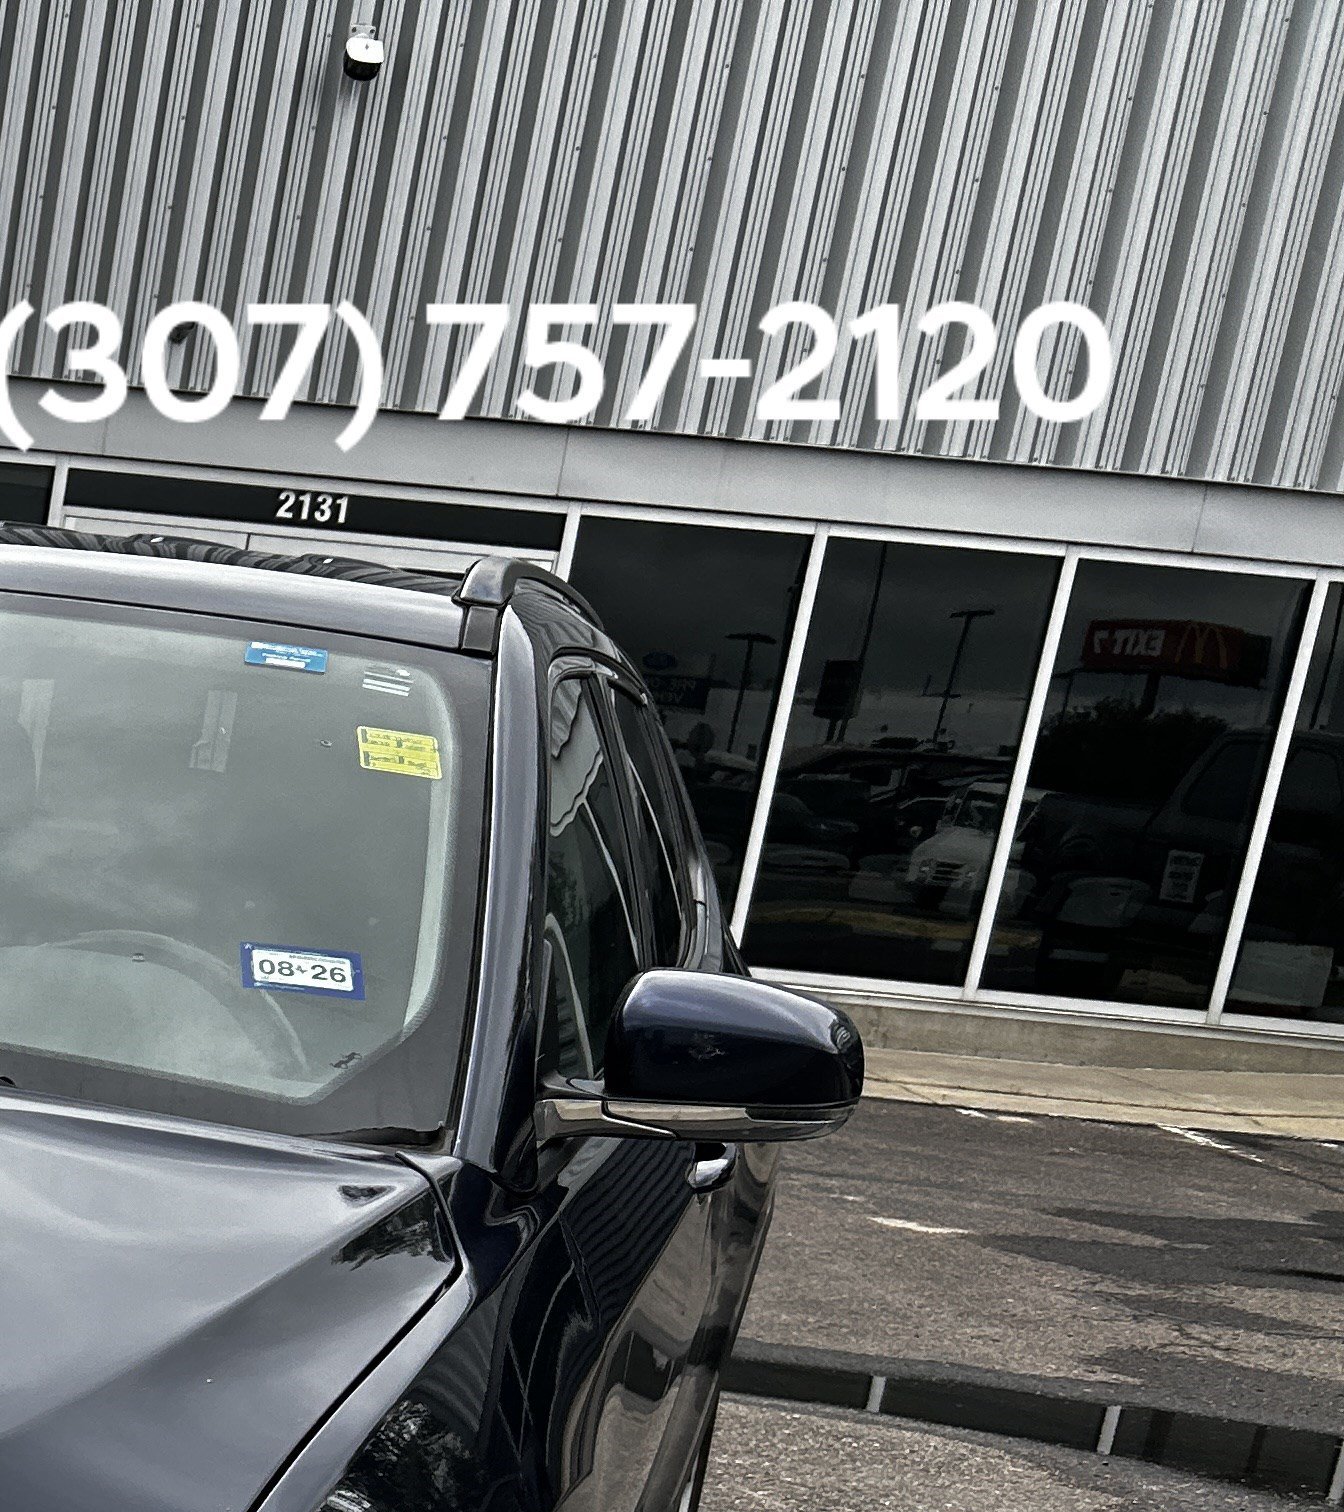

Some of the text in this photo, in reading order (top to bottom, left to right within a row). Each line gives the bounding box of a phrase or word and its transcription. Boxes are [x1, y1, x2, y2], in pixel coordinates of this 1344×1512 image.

[276, 490, 349, 525] 2131
[258, 959, 295, 977] 08
[310, 964, 346, 983] 26
